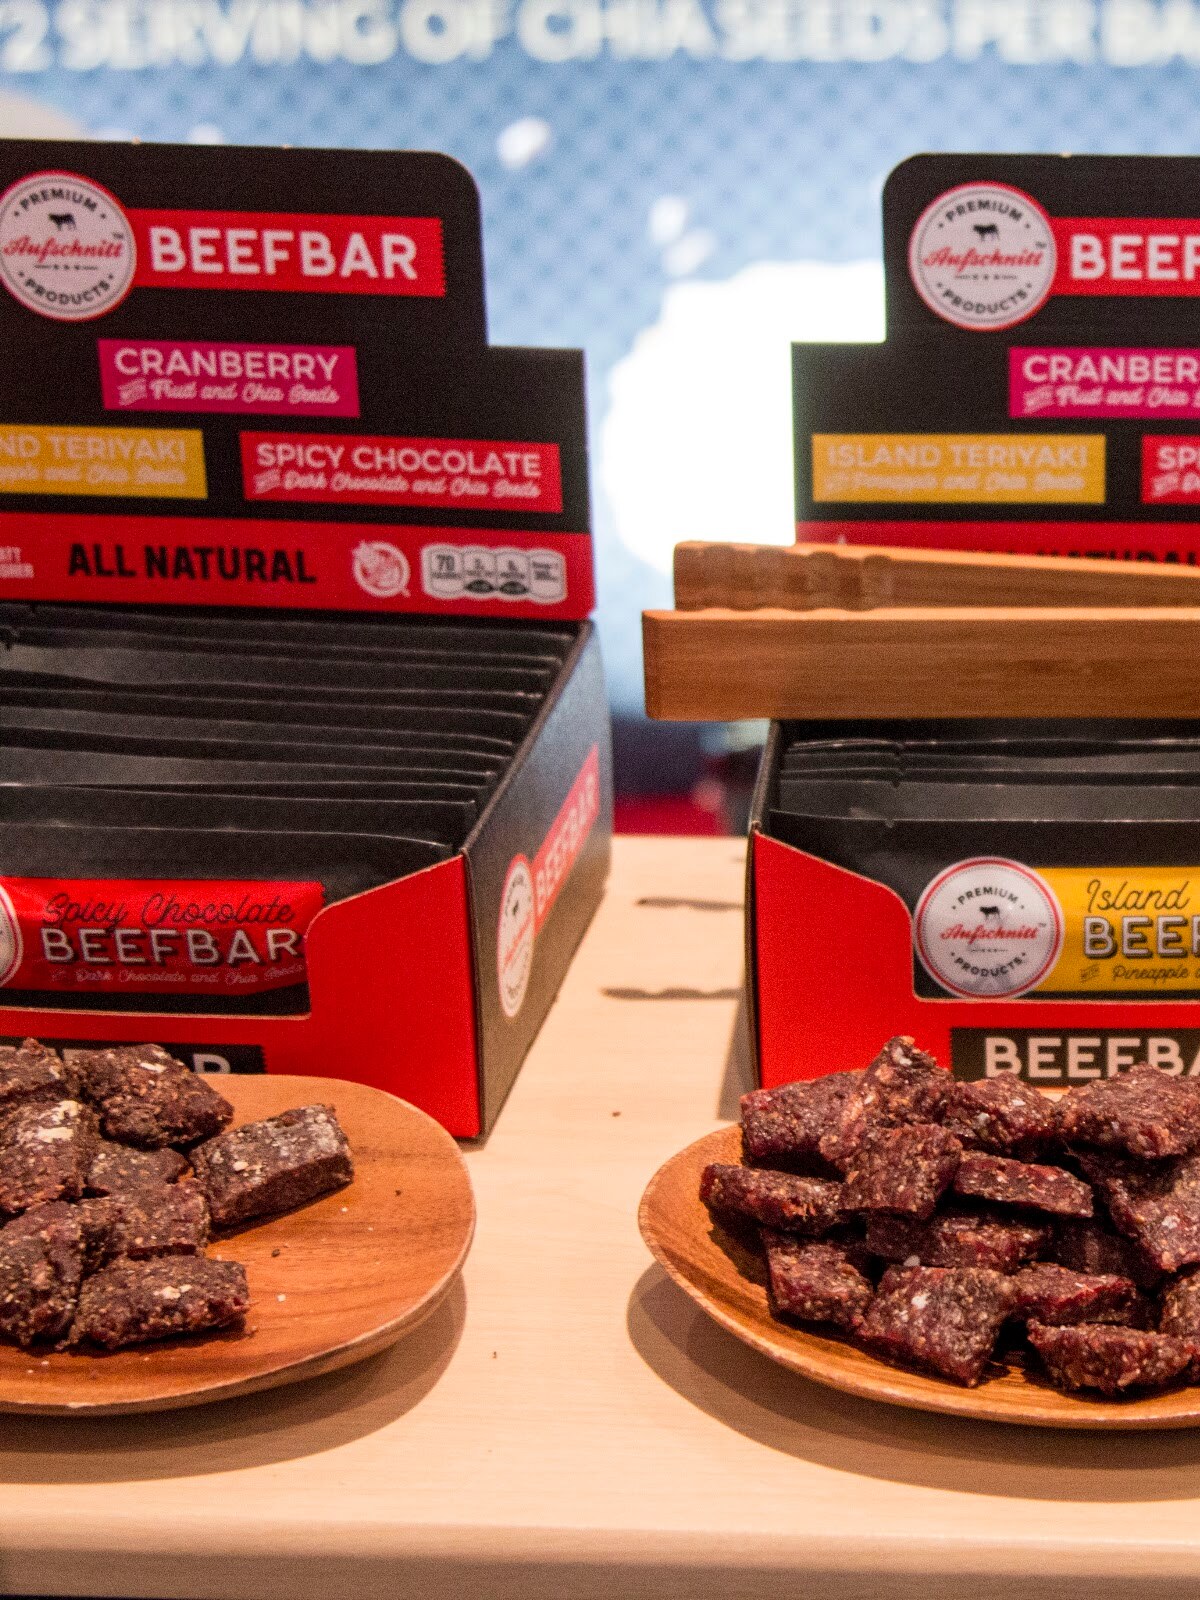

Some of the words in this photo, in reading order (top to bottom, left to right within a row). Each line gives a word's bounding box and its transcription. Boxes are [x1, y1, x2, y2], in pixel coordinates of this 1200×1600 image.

[20, 188, 98, 212] PREMIUM
[945, 199, 1023, 222] PREMIUM
[3, 236, 122, 263] Aufschnitt
[148, 226, 418, 281] BEEFBAR
[923, 247, 1044, 273] Aufschnitt
[25, 278, 111, 305] PRODUCTS
[943, 289, 1028, 314] PRODUCTS
[114, 347, 339, 381] CRANBERRY
[50, 434, 187, 463] TERIYAKI
[256, 443, 345, 469] SPICY
[352, 446, 542, 479] CHOCOLATE
[826, 444, 941, 467] ISLAND
[951, 444, 1088, 468] TERIYAKI
[68, 543, 136, 578] ALL
[145, 546, 317, 585] NATURAL
[957, 886, 1018, 904] PREMIUM
[1086, 878, 1191, 913] Island
[42, 893, 128, 930] Spicy
[140, 893, 296, 928] Chocolate
[40, 926, 304, 967] BEEFBAR
[940, 923, 1039, 945] Aufschnitt
[953, 956, 1024, 978] PRODUCTS
